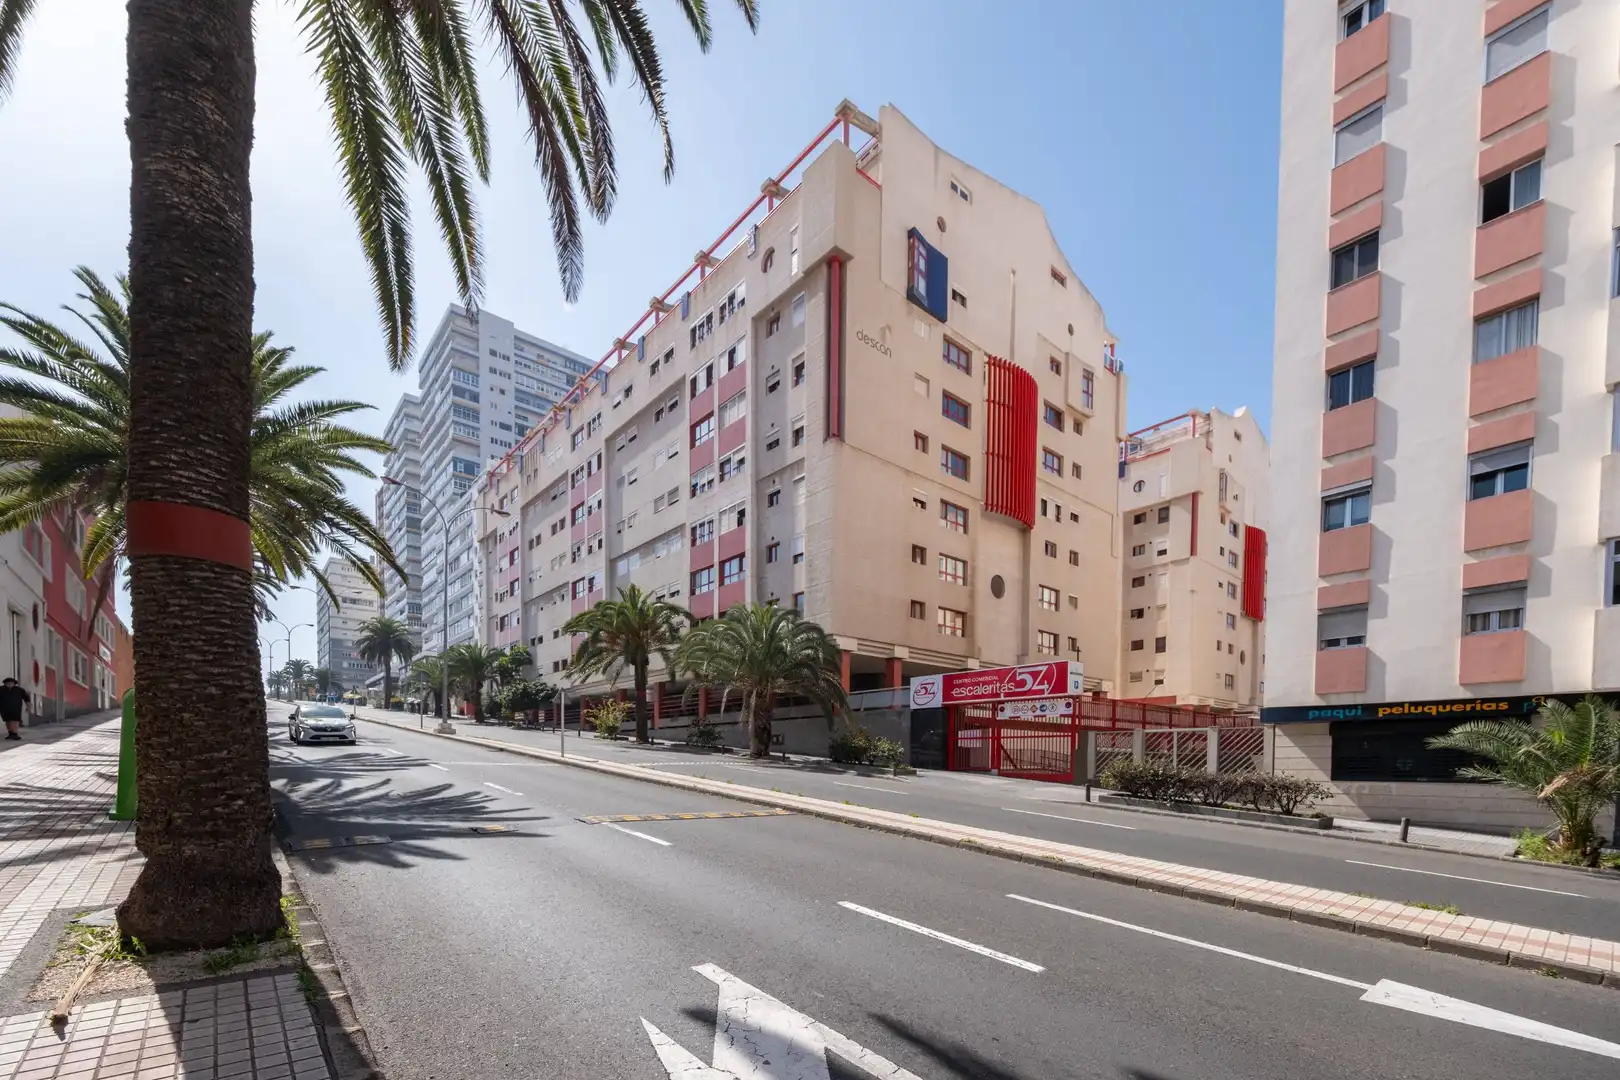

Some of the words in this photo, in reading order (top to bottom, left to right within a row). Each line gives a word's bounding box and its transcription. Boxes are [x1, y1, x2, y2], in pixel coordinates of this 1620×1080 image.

[856, 328, 892, 359] descan
[951, 681, 1015, 697] escaleritas
[1308, 705, 1363, 720] paqui
[1378, 700, 1509, 717] peluquerías
